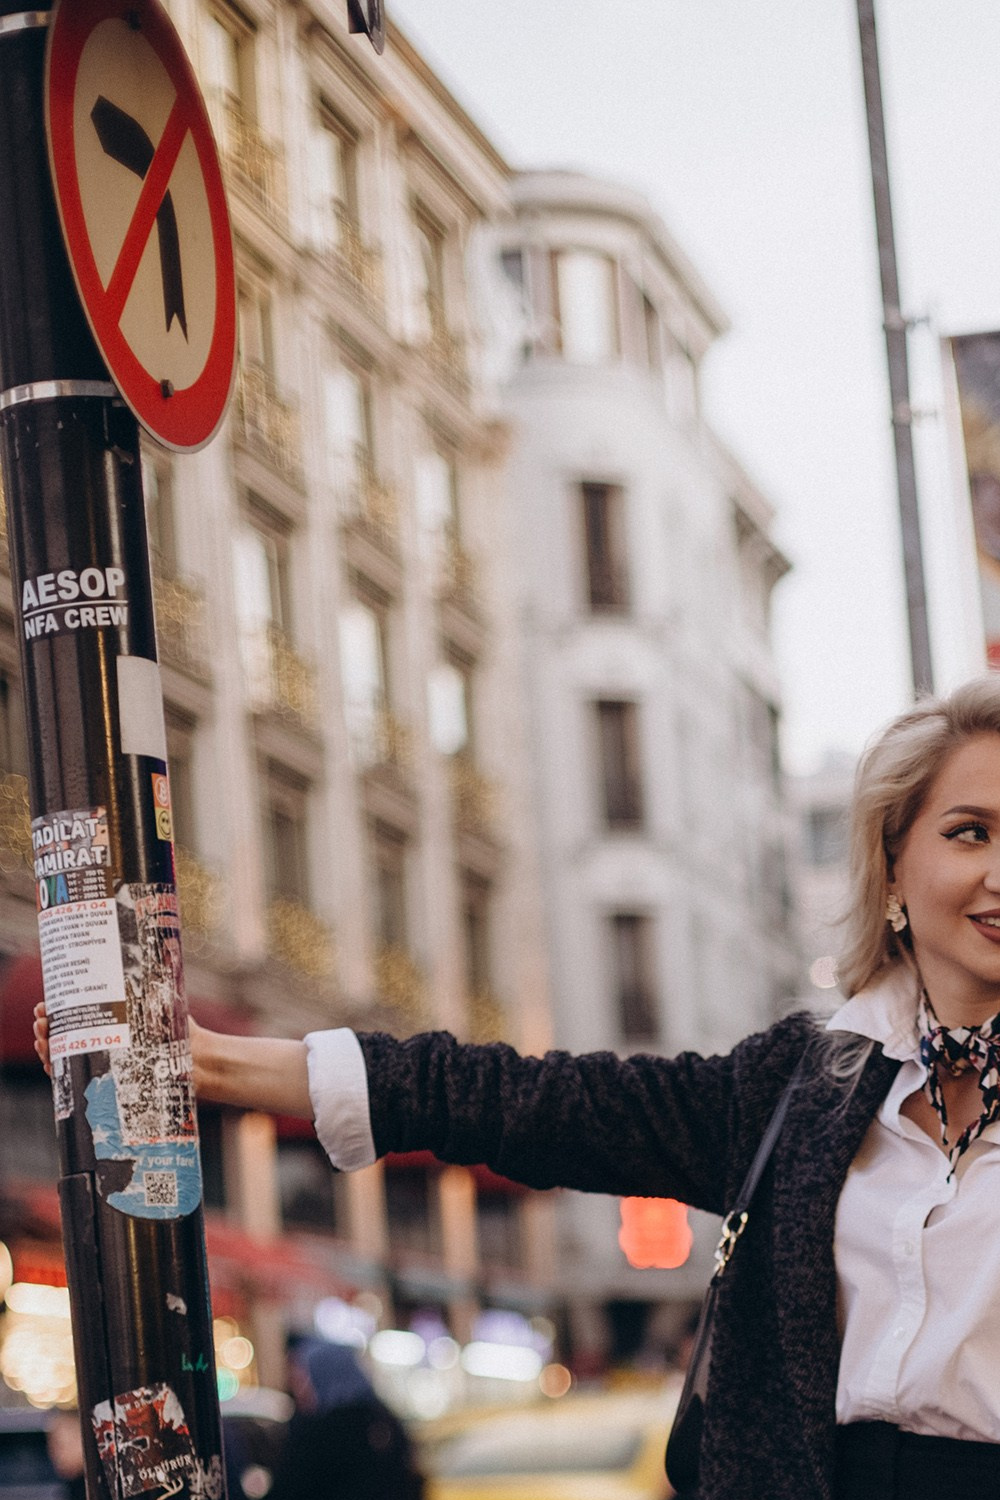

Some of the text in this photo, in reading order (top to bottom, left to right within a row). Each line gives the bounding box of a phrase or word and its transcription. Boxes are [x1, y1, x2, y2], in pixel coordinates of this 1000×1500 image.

[22, 567, 125, 611] AESOP
[24, 606, 128, 639] NFA CREW
[36, 873, 69, 910] OYA
[76, 903, 87, 912] 71
[90, 901, 107, 909] 04
[90, 910, 113, 918] DUVAR
[85, 920, 108, 928] DUVAR
[70, 931, 90, 939] TAVAN
[84, 983, 108, 992] GRANİT
[69, 1040, 87, 1049] 426
[90, 1038, 101, 1047] 71
[105, 1035, 122, 1044] 04
[147, 1156, 173, 1168] your
